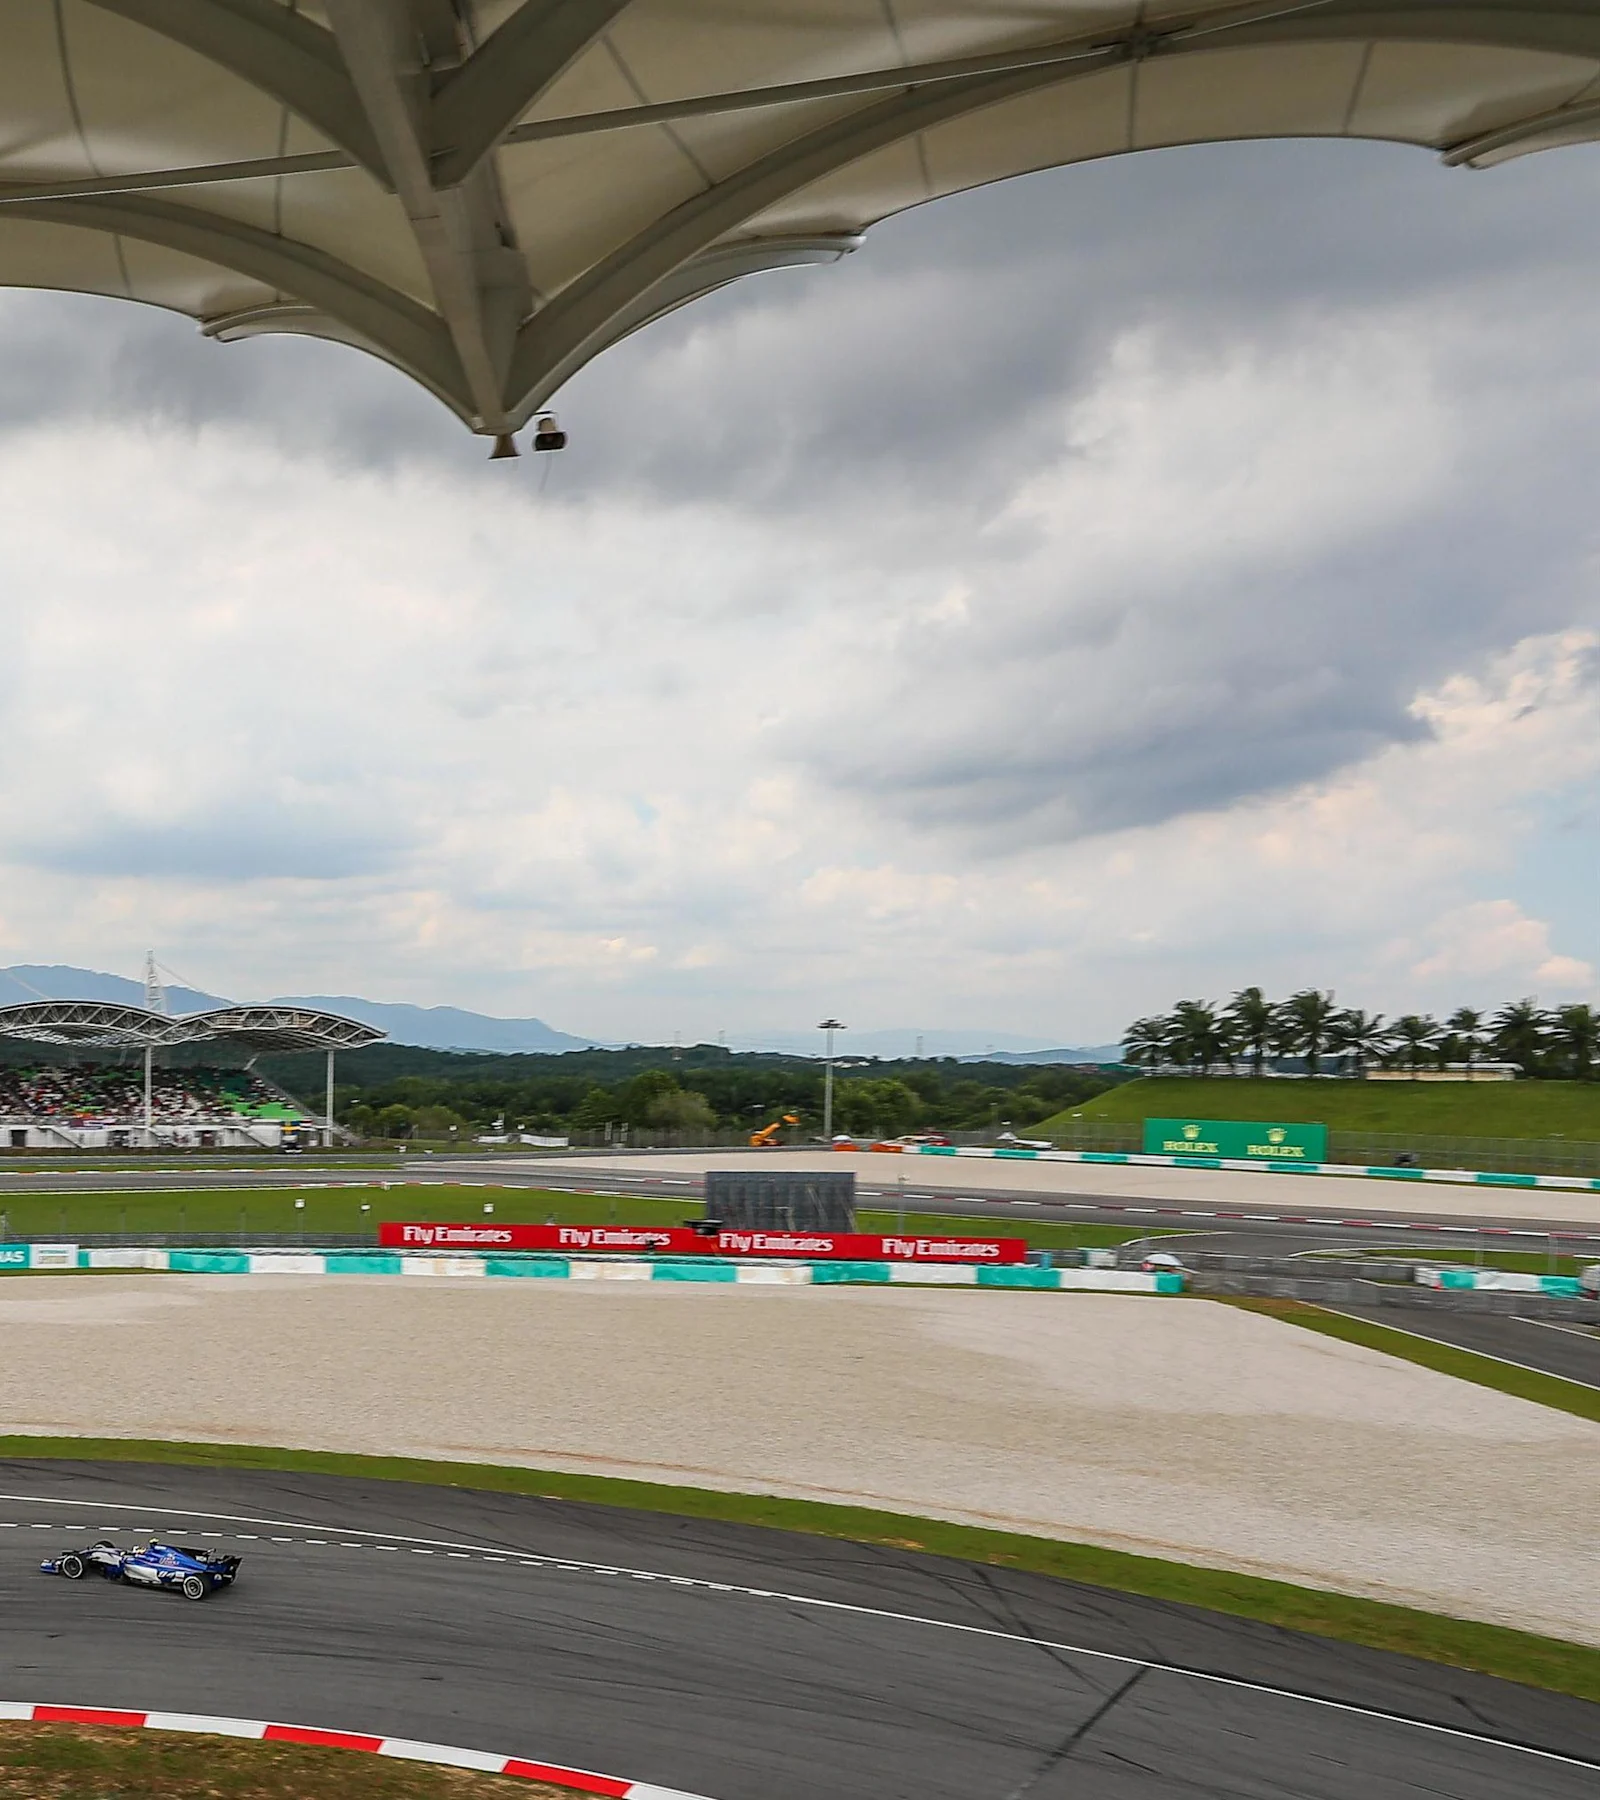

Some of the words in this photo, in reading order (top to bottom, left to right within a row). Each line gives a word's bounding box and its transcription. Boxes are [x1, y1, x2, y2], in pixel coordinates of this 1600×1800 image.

[1163, 1141, 1219, 1153] ROLEX
[1247, 1145, 1305, 1157] ROLEX
[403, 1226, 434, 1244] Fly
[435, 1226, 512, 1243] Emirates
[559, 1229, 590, 1246] Fly
[592, 1229, 670, 1245] Emirates
[719, 1233, 751, 1252] Fly
[752, 1234, 833, 1251] Emirates
[882, 1238, 914, 1257] Fly
[916, 1240, 999, 1256] Emirates
